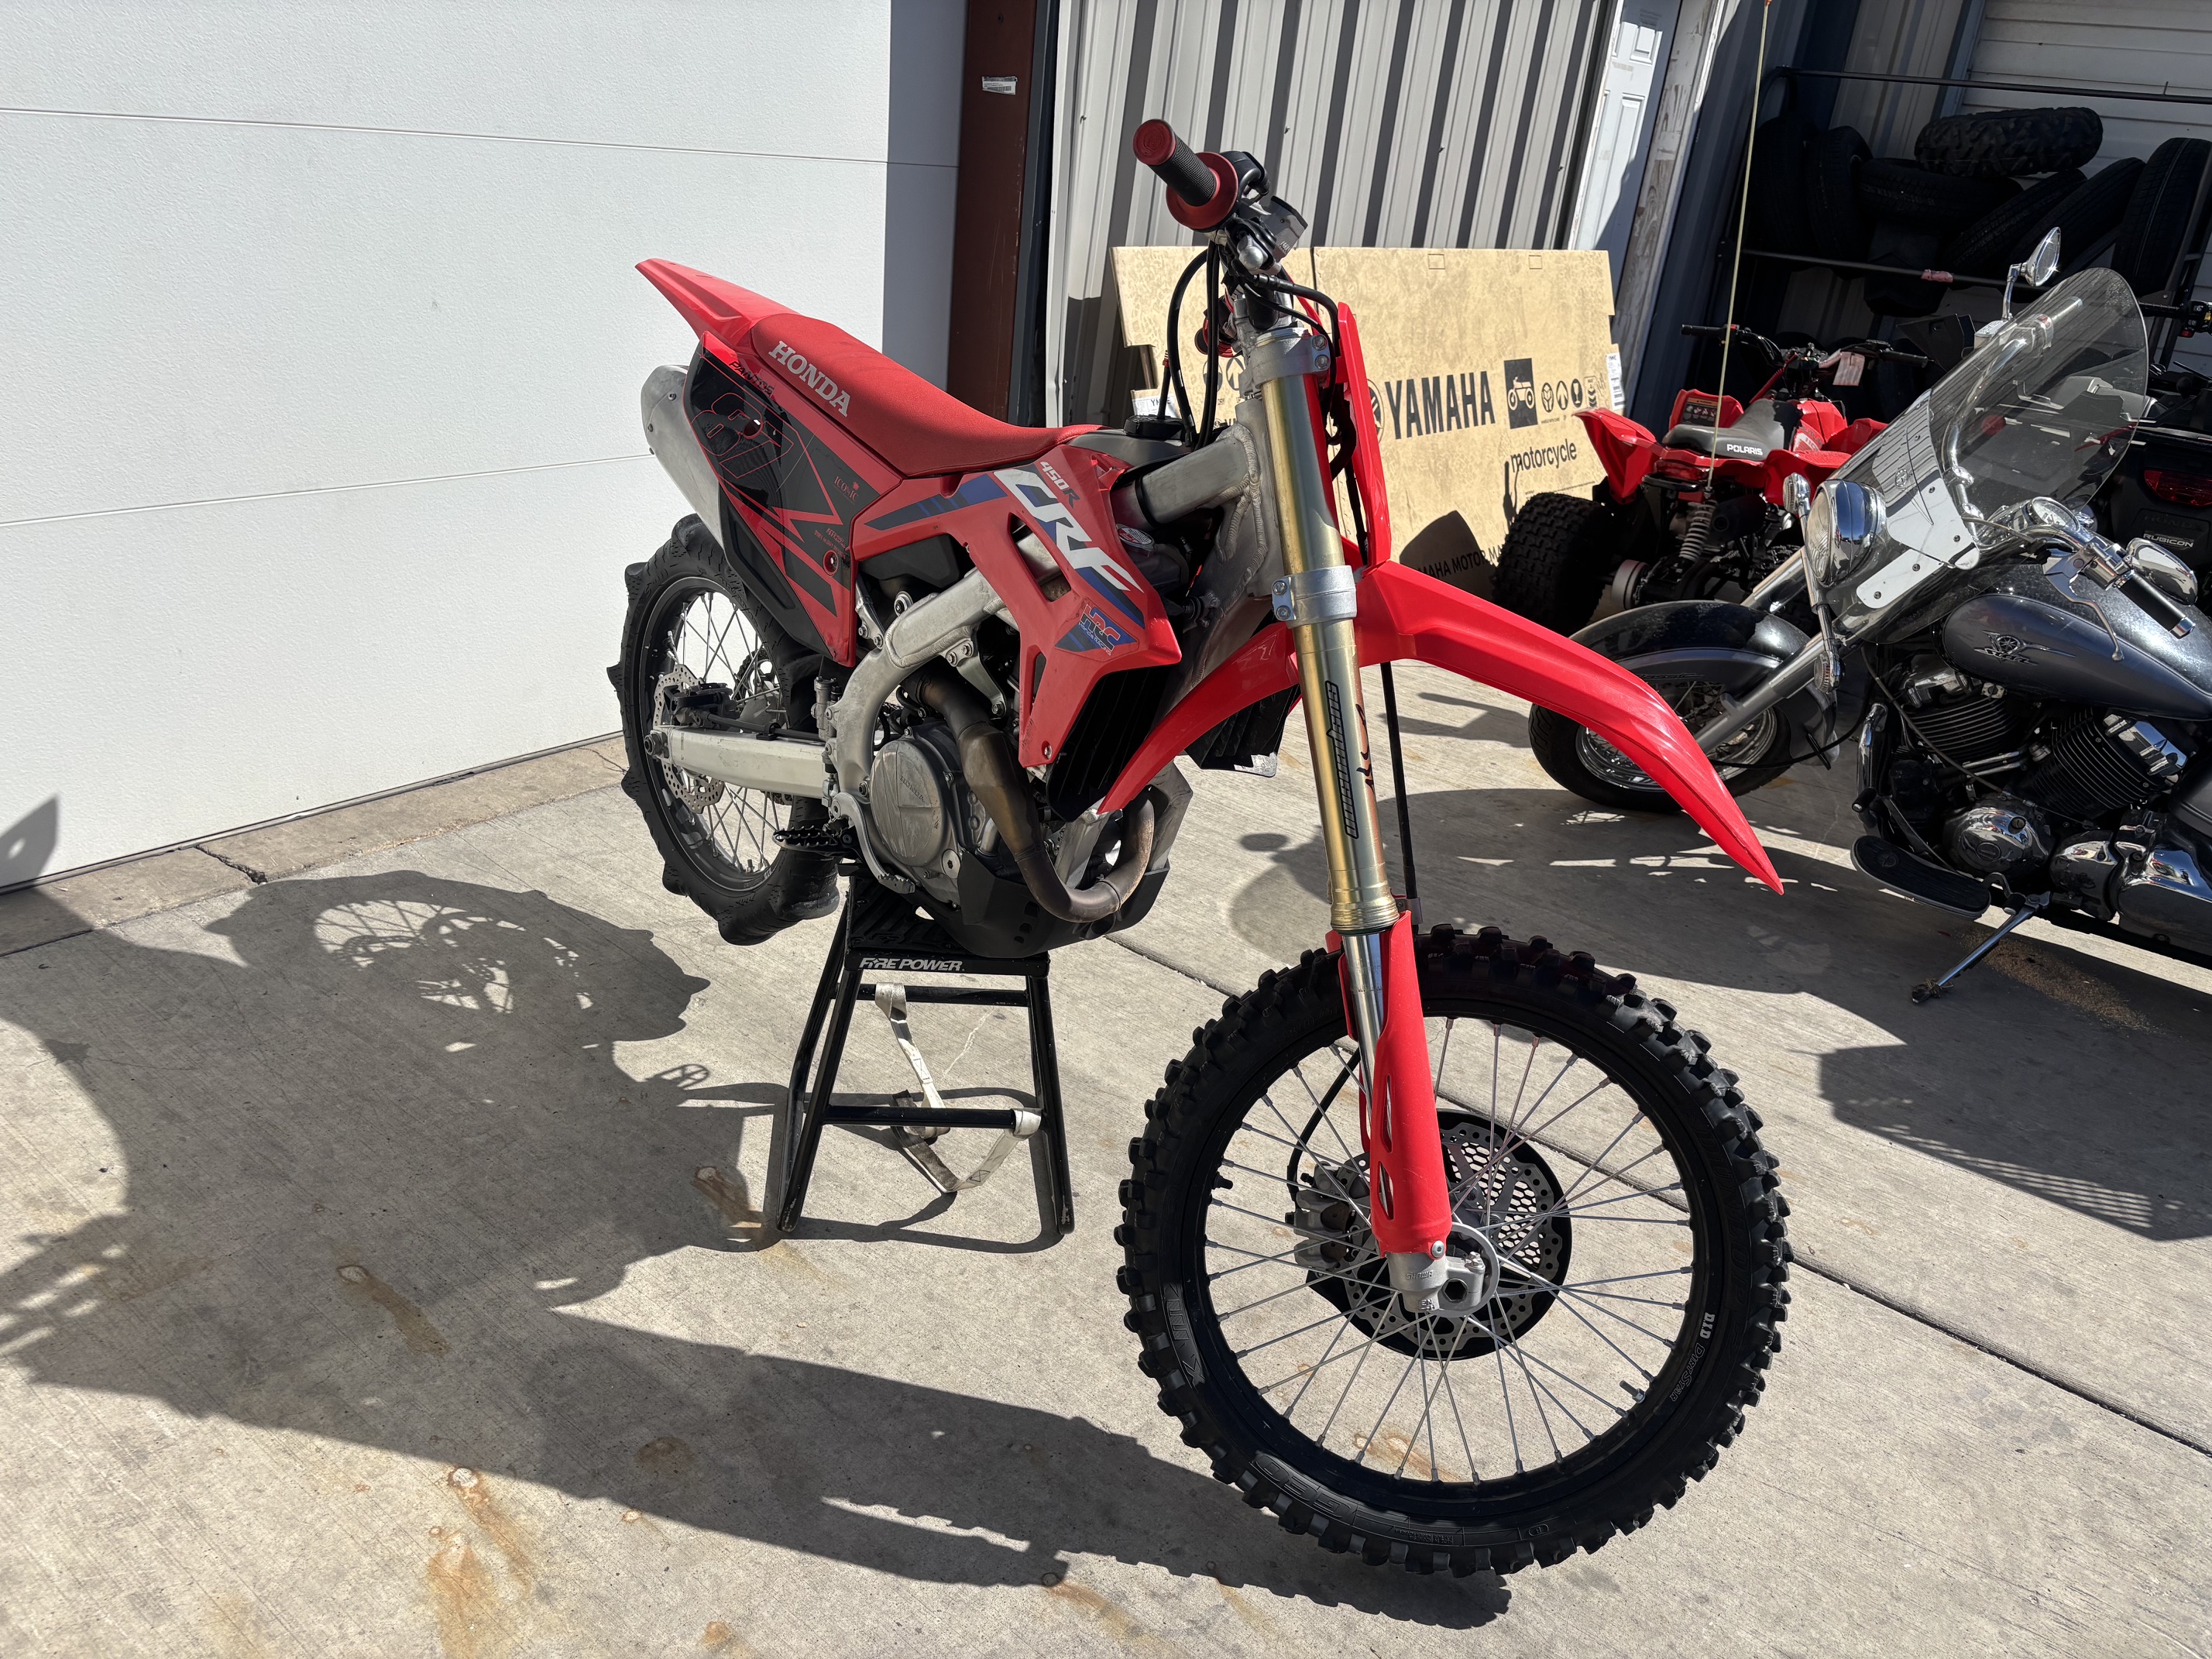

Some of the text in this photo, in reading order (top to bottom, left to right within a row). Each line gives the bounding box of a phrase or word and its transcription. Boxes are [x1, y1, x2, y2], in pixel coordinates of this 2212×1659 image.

[768, 340, 852, 417] HONDA
[1385, 371, 1496, 439] YAMAHA
[1510, 438, 1578, 473] motorcycle
[1726, 444, 1764, 456] POLARIS
[1040, 461, 1080, 509] 450R
[993, 468, 1145, 594] CRF
[2143, 533, 2194, 548] RUBICON
[1417, 559, 1451, 579] MAHA
[1325, 680, 1358, 839] suspension
[859, 957, 963, 971] FIRE POWER
